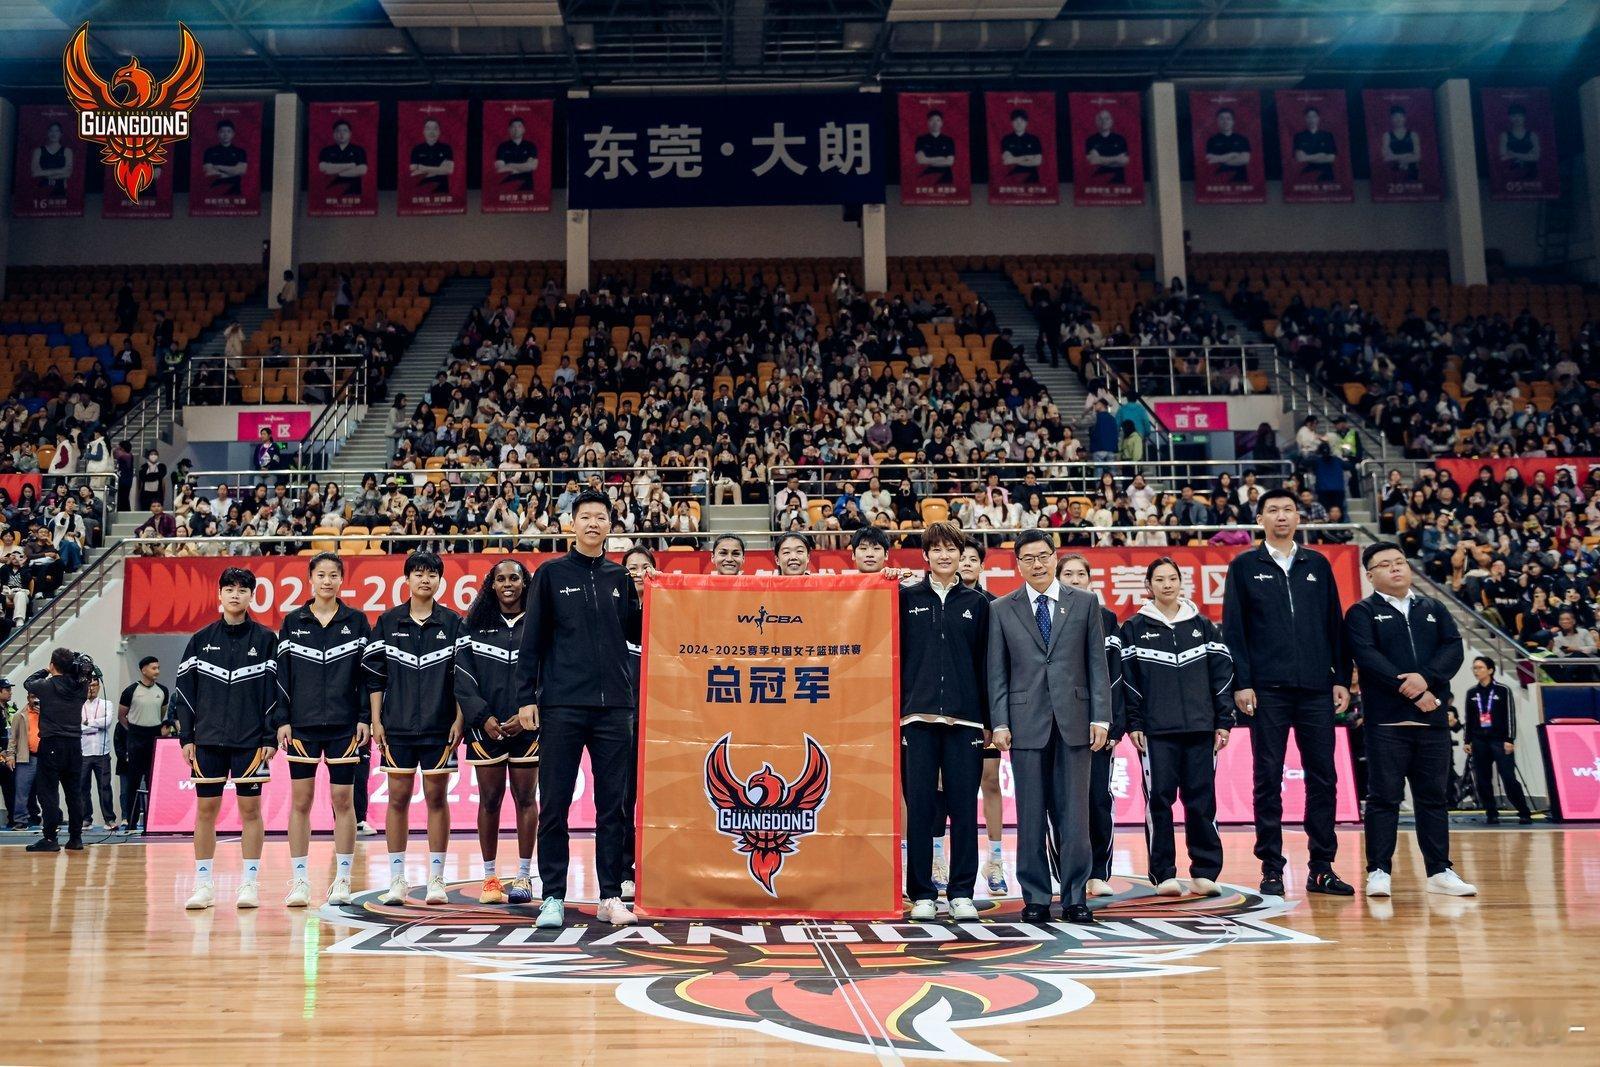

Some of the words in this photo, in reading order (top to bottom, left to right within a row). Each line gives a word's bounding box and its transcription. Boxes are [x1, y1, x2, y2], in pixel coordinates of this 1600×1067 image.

[584, 121, 871, 180] 东莞·大朗
[705, 665, 831, 704] 总冠军
[720, 808, 814, 831] GUANGDONG
[379, 917, 1275, 948] GUANGDONG
